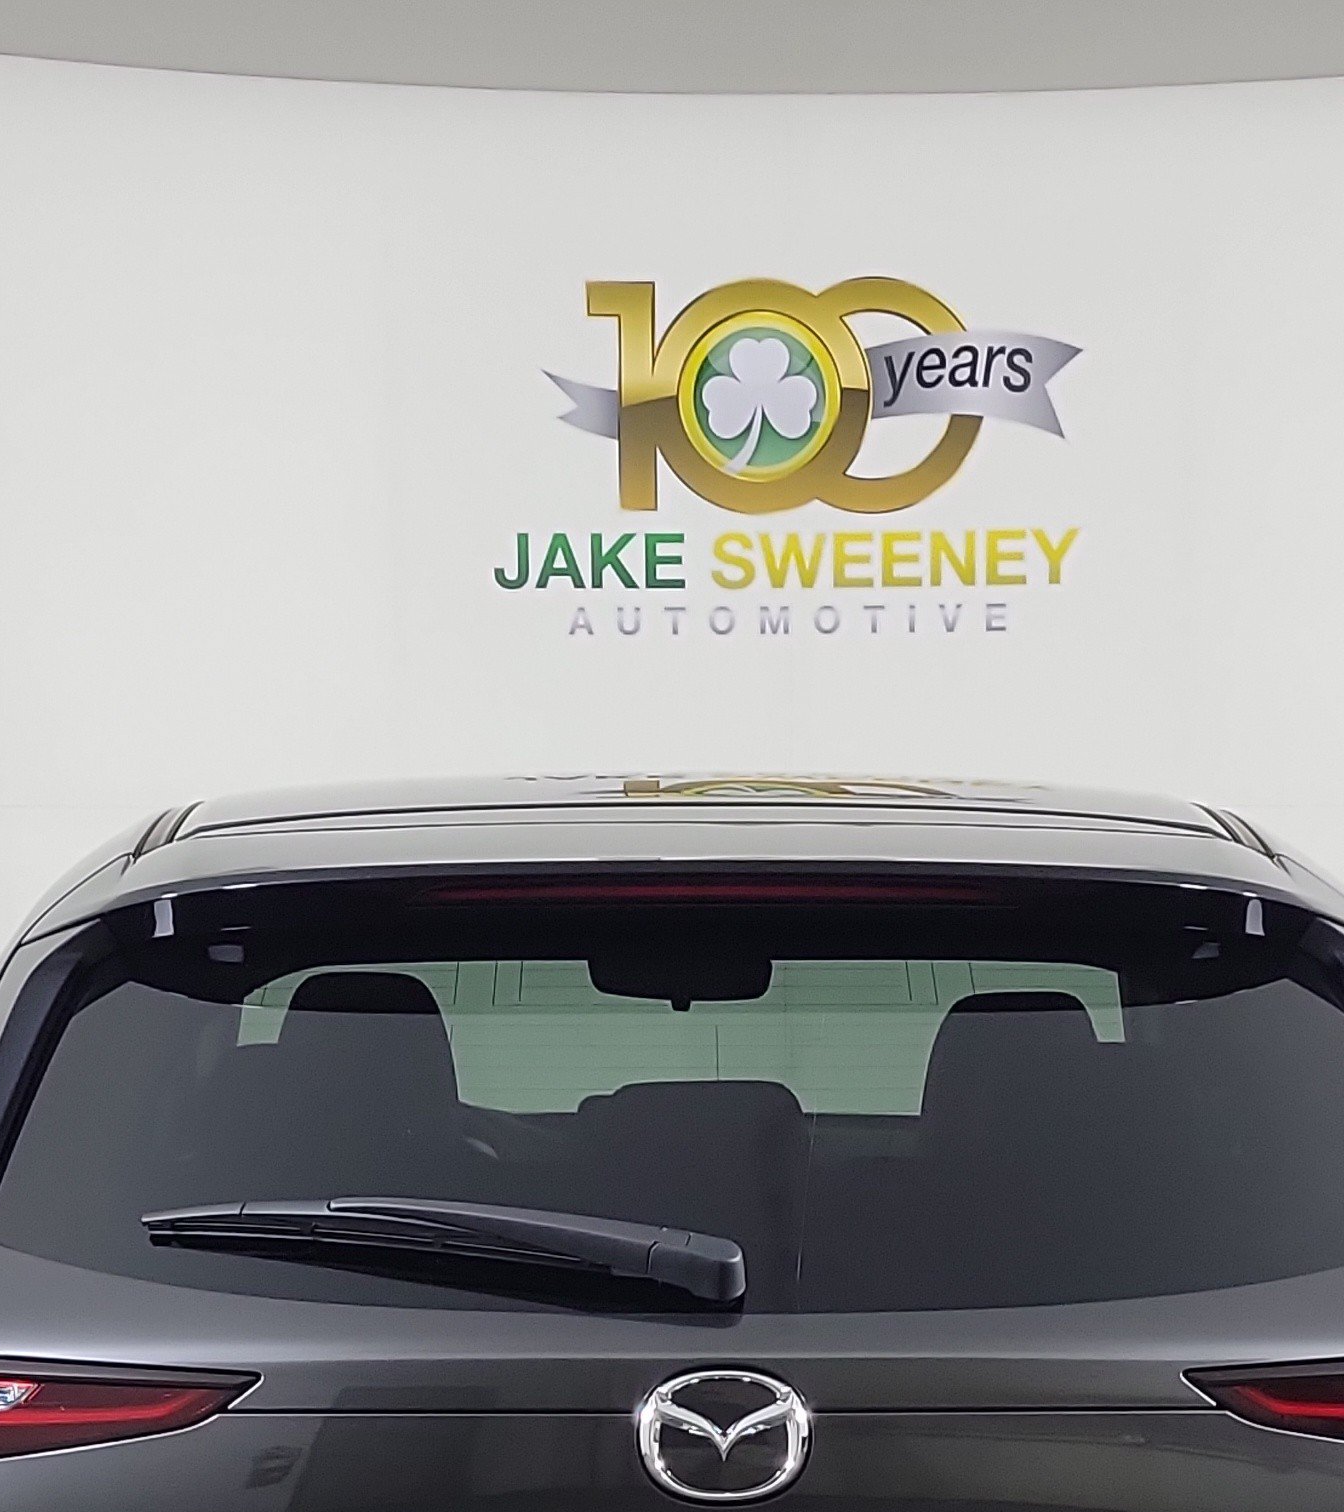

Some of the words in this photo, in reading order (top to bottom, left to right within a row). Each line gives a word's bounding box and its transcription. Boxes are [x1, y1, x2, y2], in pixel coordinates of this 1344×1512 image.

[883, 342, 1034, 408] years
[493, 532, 687, 590] JAKE
[710, 528, 1080, 589] SWEENEY
[567, 602, 1008, 636] AUTOMOTIVE
